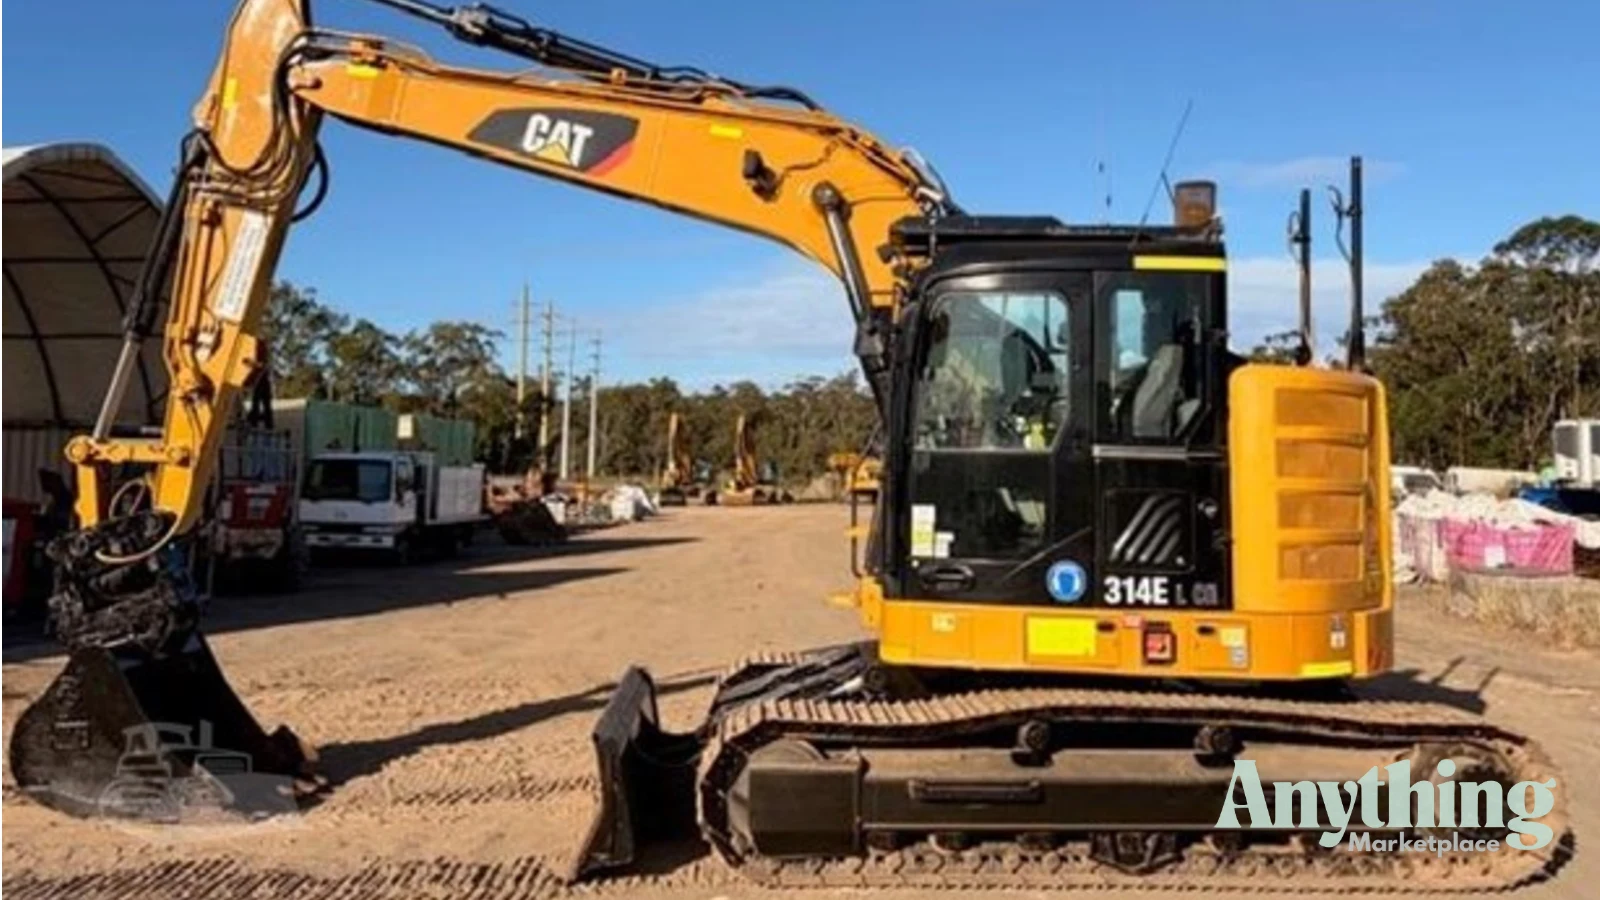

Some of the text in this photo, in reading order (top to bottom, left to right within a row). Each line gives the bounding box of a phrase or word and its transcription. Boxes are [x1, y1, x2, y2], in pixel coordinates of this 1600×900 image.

[522, 112, 594, 168] CAT
[1103, 575, 1169, 605] 314E
[1175, 583, 1187, 605] L
